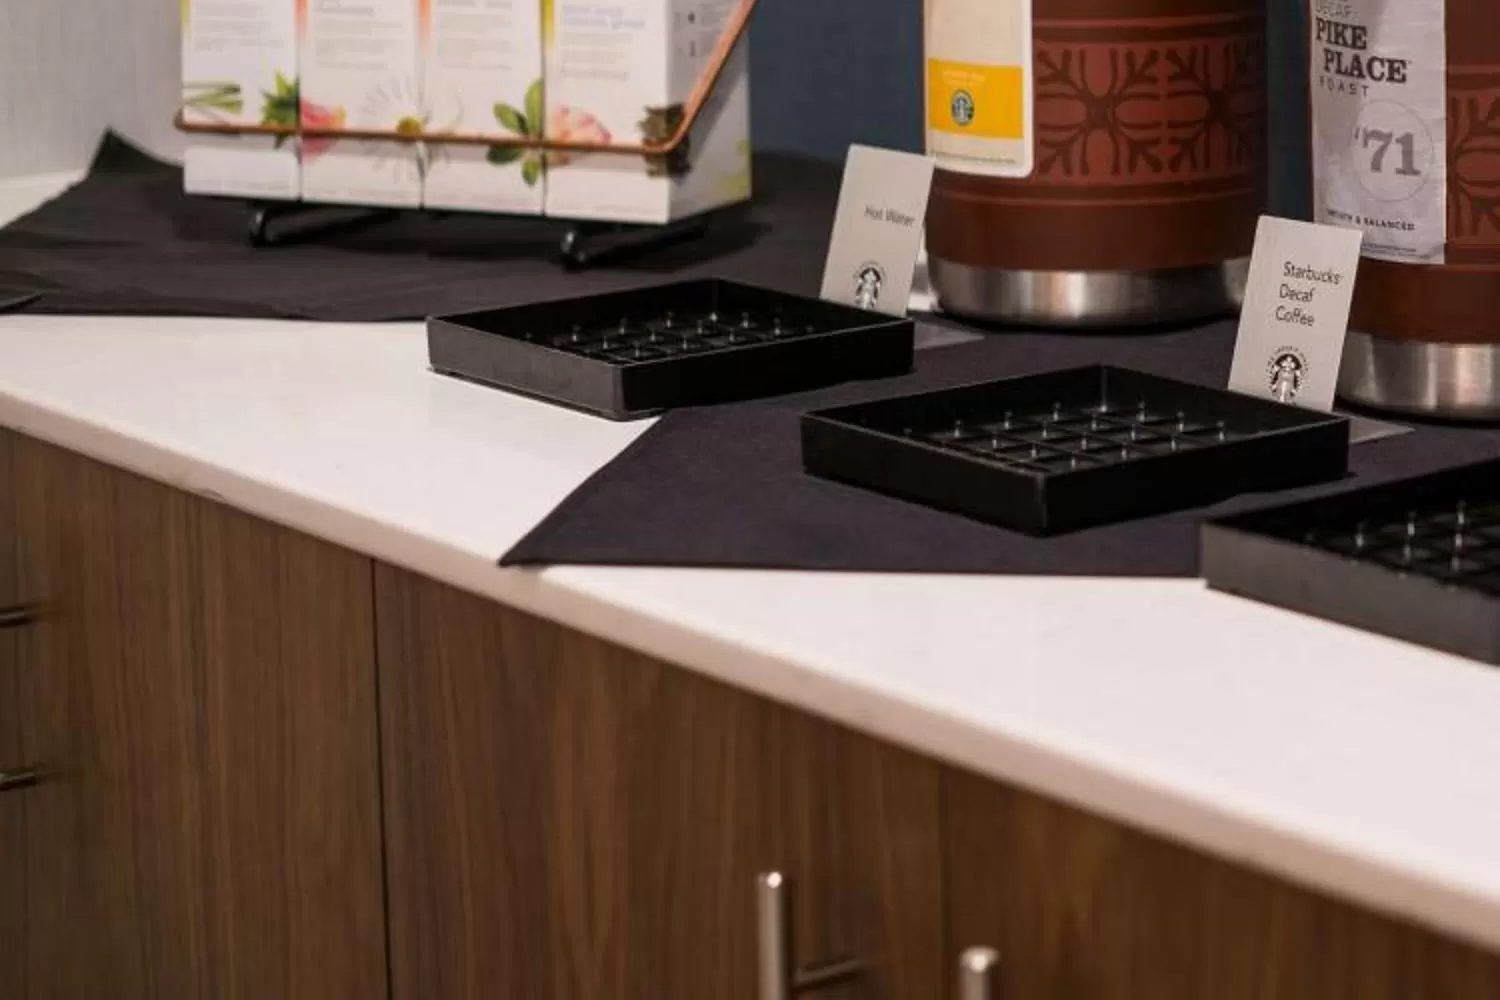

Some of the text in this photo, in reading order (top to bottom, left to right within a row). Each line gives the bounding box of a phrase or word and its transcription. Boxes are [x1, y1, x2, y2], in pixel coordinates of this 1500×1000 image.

[1315, 16, 1368, 50] PIKE
[1323, 47, 1408, 84] PLACE
[1355, 126, 1421, 176] '71
[864, 205, 916, 228] Hot Water
[1283, 261, 1343, 285] Starbucks
[1279, 283, 1316, 303] Decaf
[1275, 305, 1315, 326] Coffee
